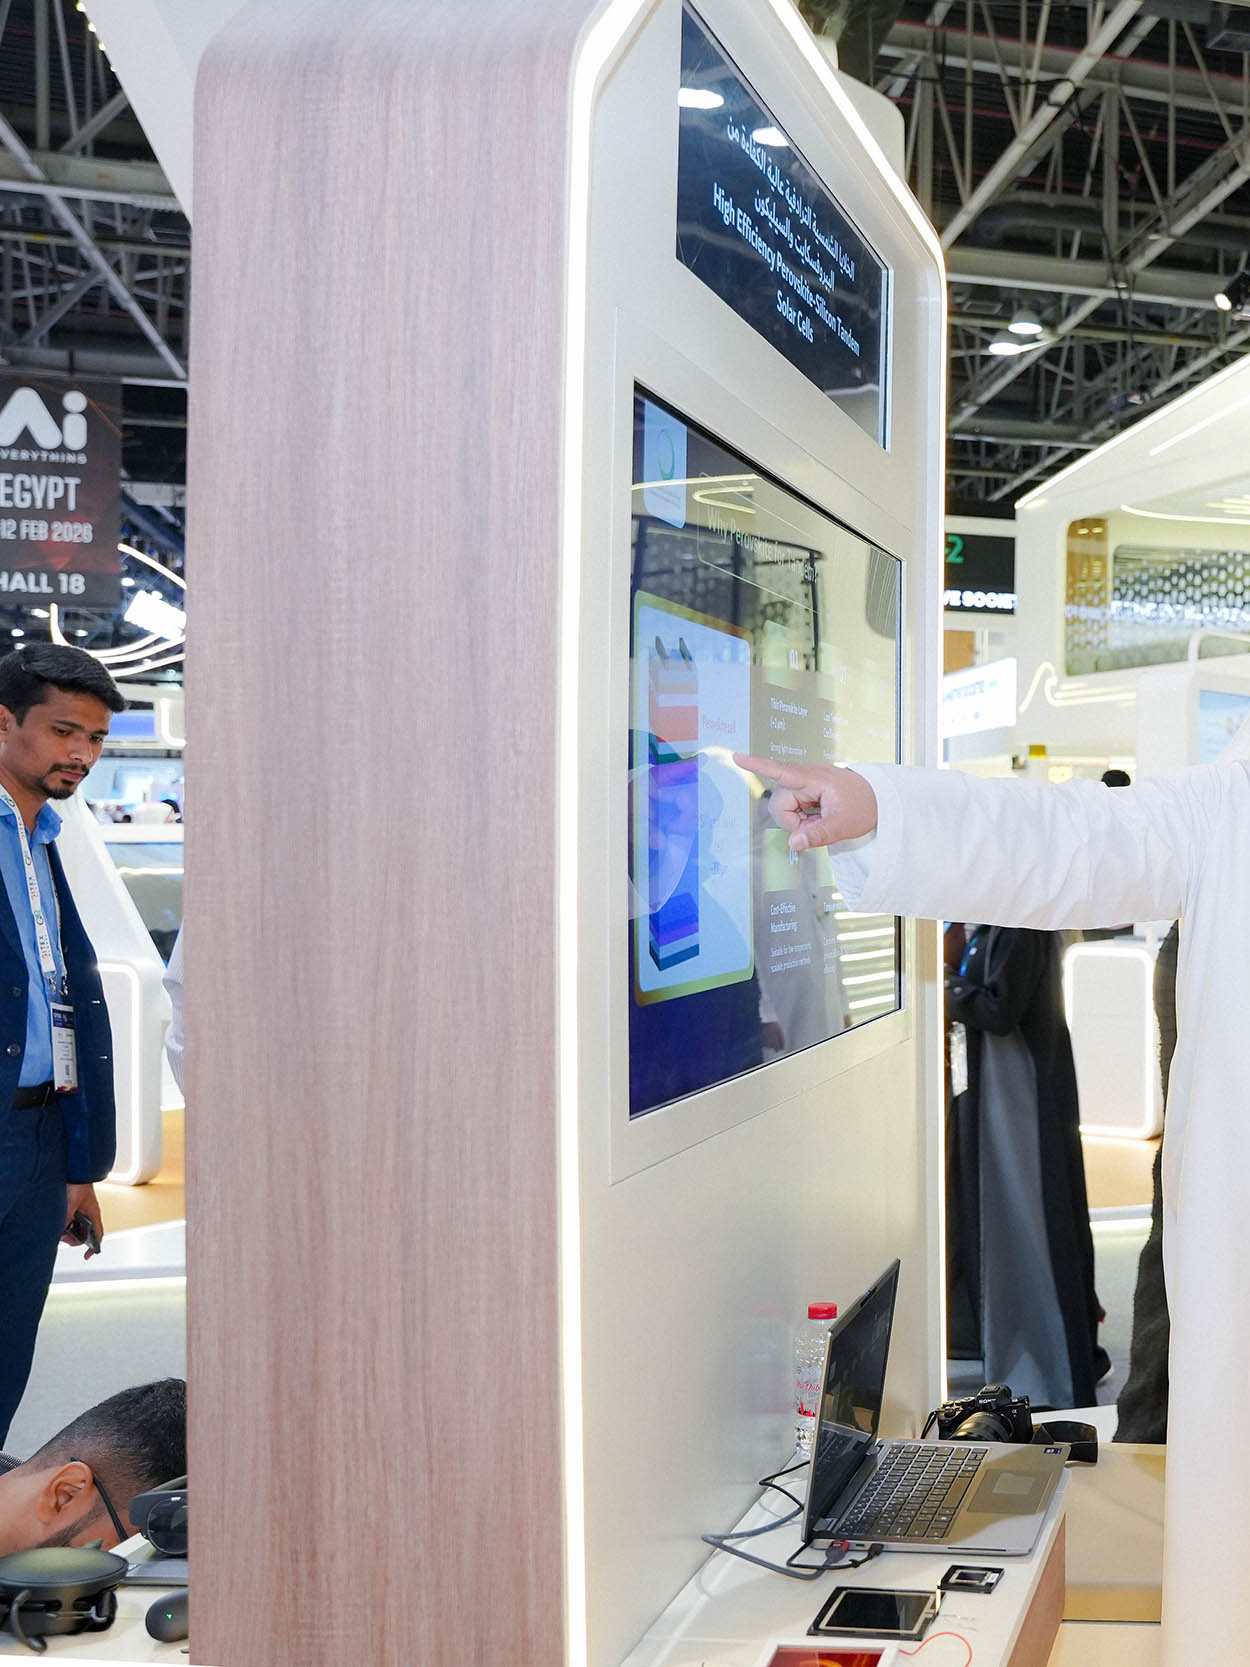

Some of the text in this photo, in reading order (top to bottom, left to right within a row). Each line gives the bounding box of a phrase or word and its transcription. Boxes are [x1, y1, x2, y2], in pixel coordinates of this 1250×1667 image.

[727, 116, 740, 143] من
[766, 157, 785, 196] عالية
[784, 179, 812, 229] الترادفية
[812, 213, 839, 262] الشمسية
[713, 182, 861, 357] High Efficiency Perovskite-Silicon Tandem
[838, 245, 856, 282] الخلايا
[776, 289, 814, 344] Solar Cells
[0, 472, 82, 512] EGYPT
[20, 519, 49, 541] FEB
[707, 504, 729, 545] Why
[58, 572, 86, 595] 18
